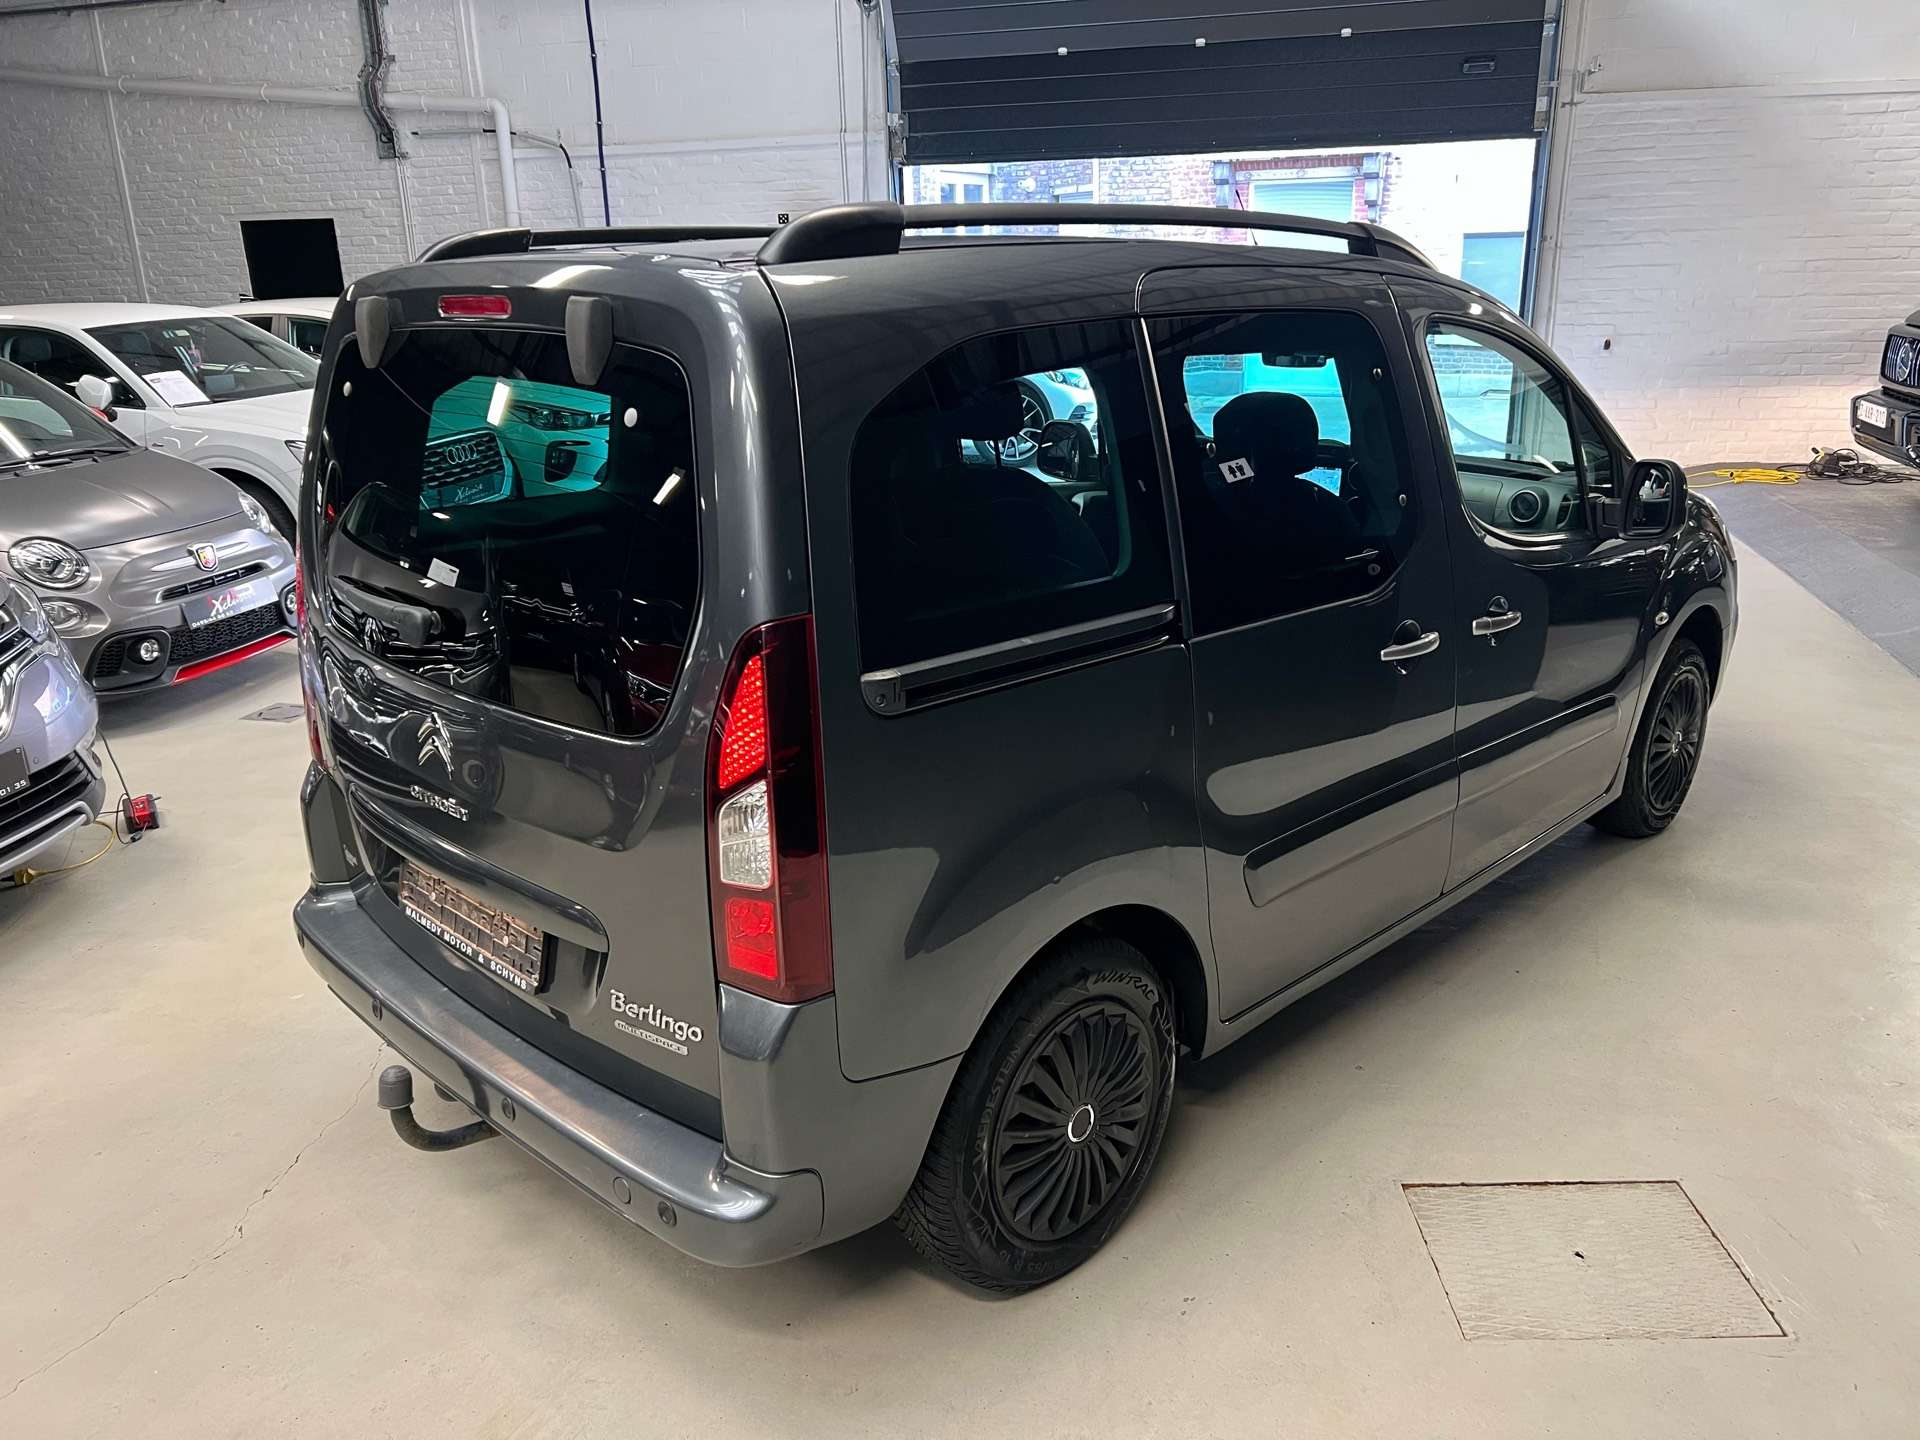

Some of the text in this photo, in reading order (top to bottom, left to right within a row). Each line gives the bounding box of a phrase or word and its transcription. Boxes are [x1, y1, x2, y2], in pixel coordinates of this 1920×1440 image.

[14, 780, 26, 790] 35
[405, 906, 527, 990] MALMEDY MOTOR & SCHYNS
[610, 988, 703, 1042] Berlingo
